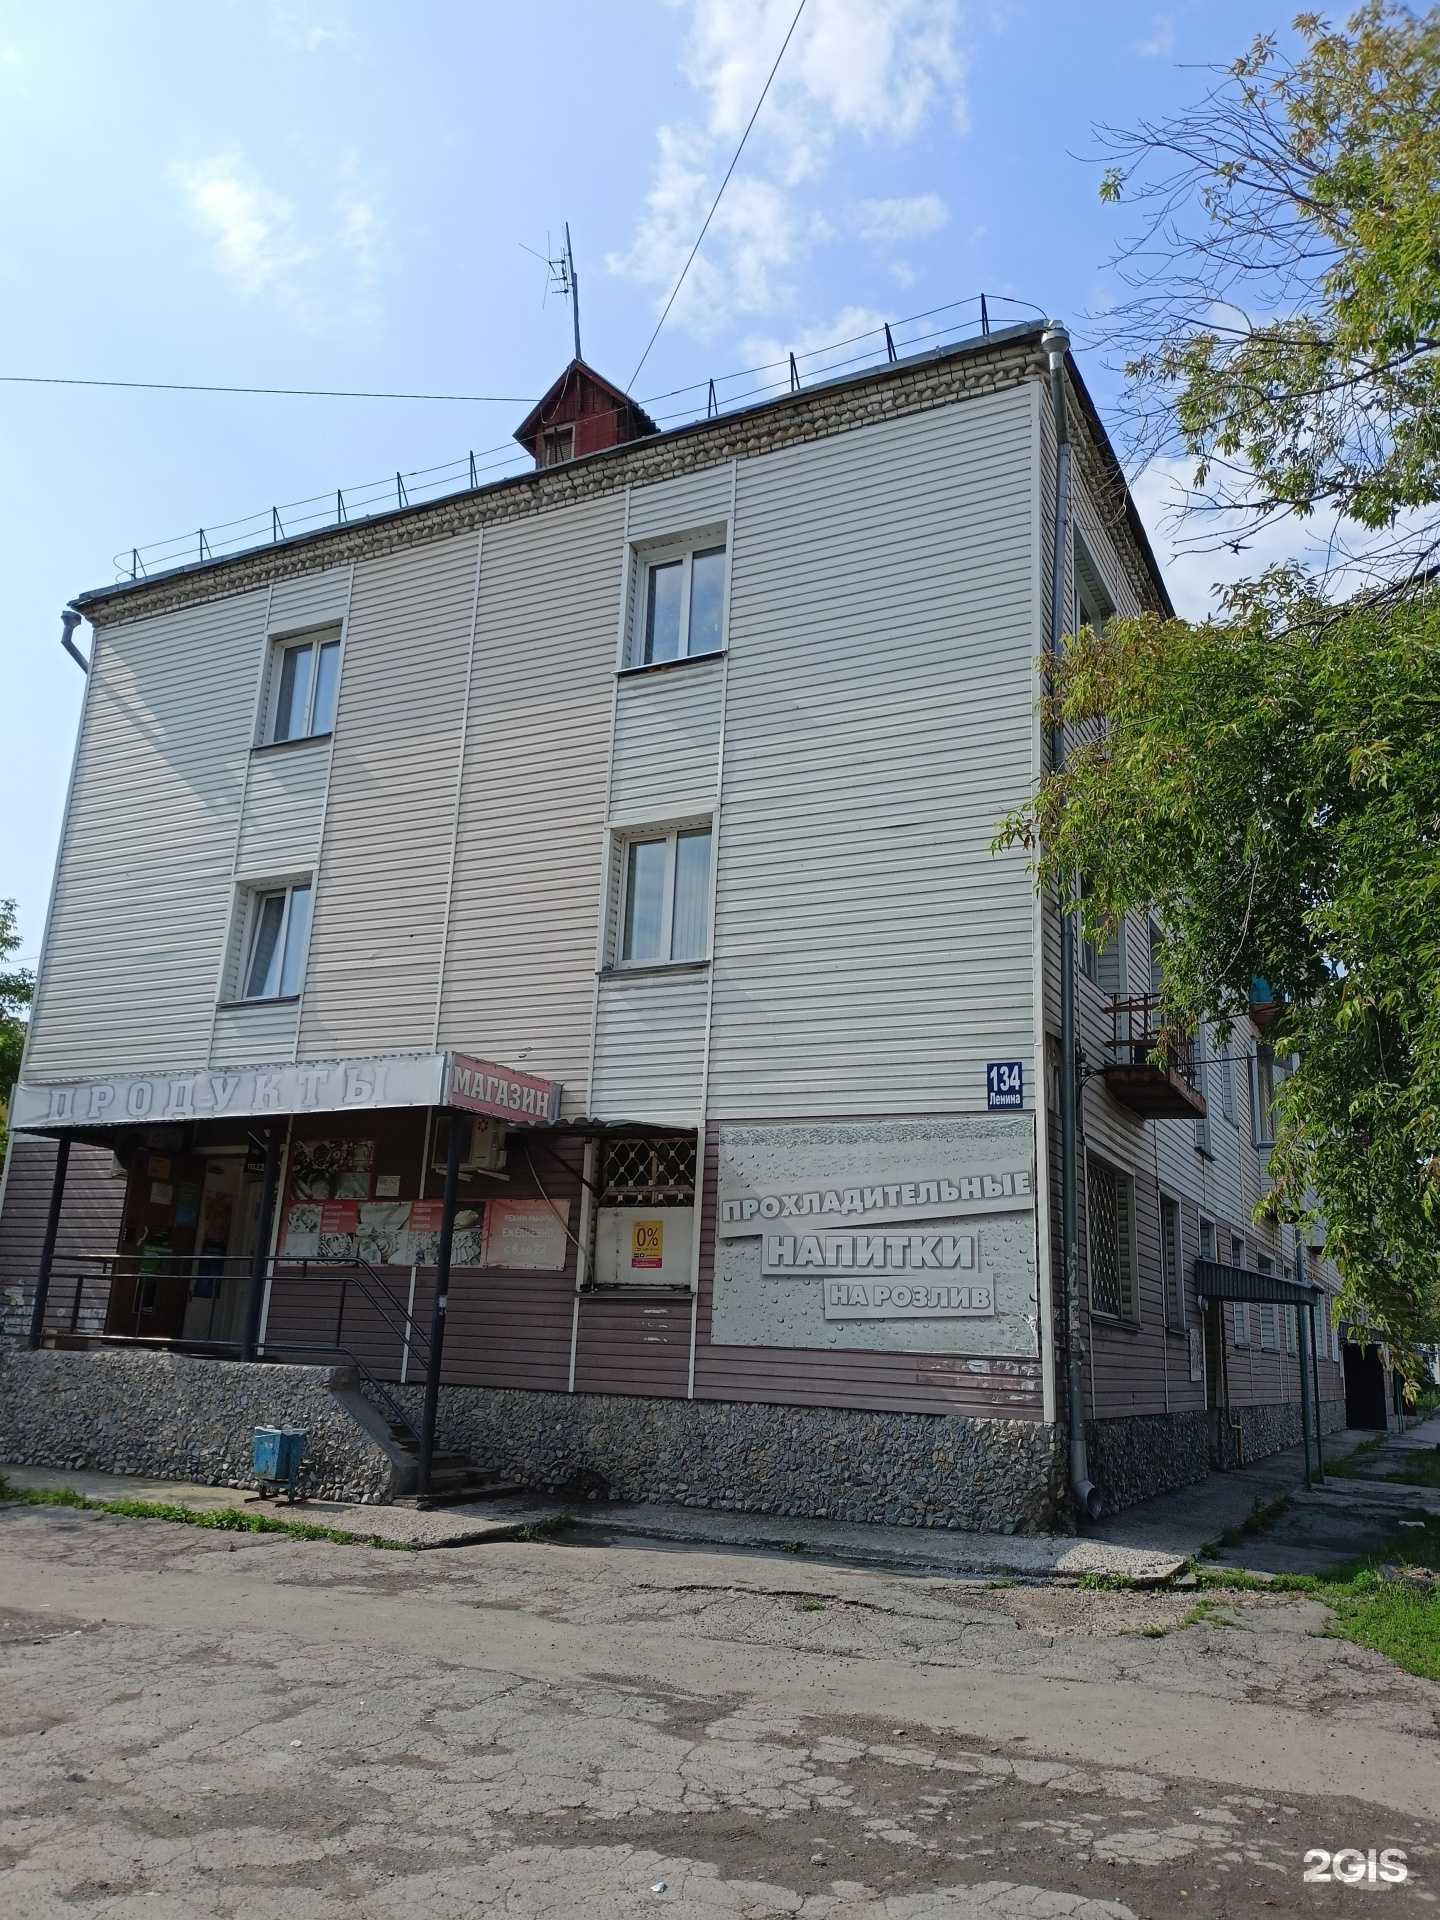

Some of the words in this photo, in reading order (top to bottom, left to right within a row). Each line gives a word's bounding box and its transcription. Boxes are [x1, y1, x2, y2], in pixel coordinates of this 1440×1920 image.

[48, 1065, 388, 1121] ПРОДУКТЫ
[453, 1066, 549, 1117] МАГАЗИН
[990, 1065, 1020, 1091] 134
[990, 1092, 1020, 1105] Ленина
[721, 1171, 1032, 1222] ПРОХЛАДИТЕЛЬНЫЕ
[636, 1227, 659, 1247] 0%
[767, 1235, 974, 1269] НАПИТКИ
[830, 1284, 869, 1306] НА
[873, 1284, 991, 1309] РОЗЛИВ
